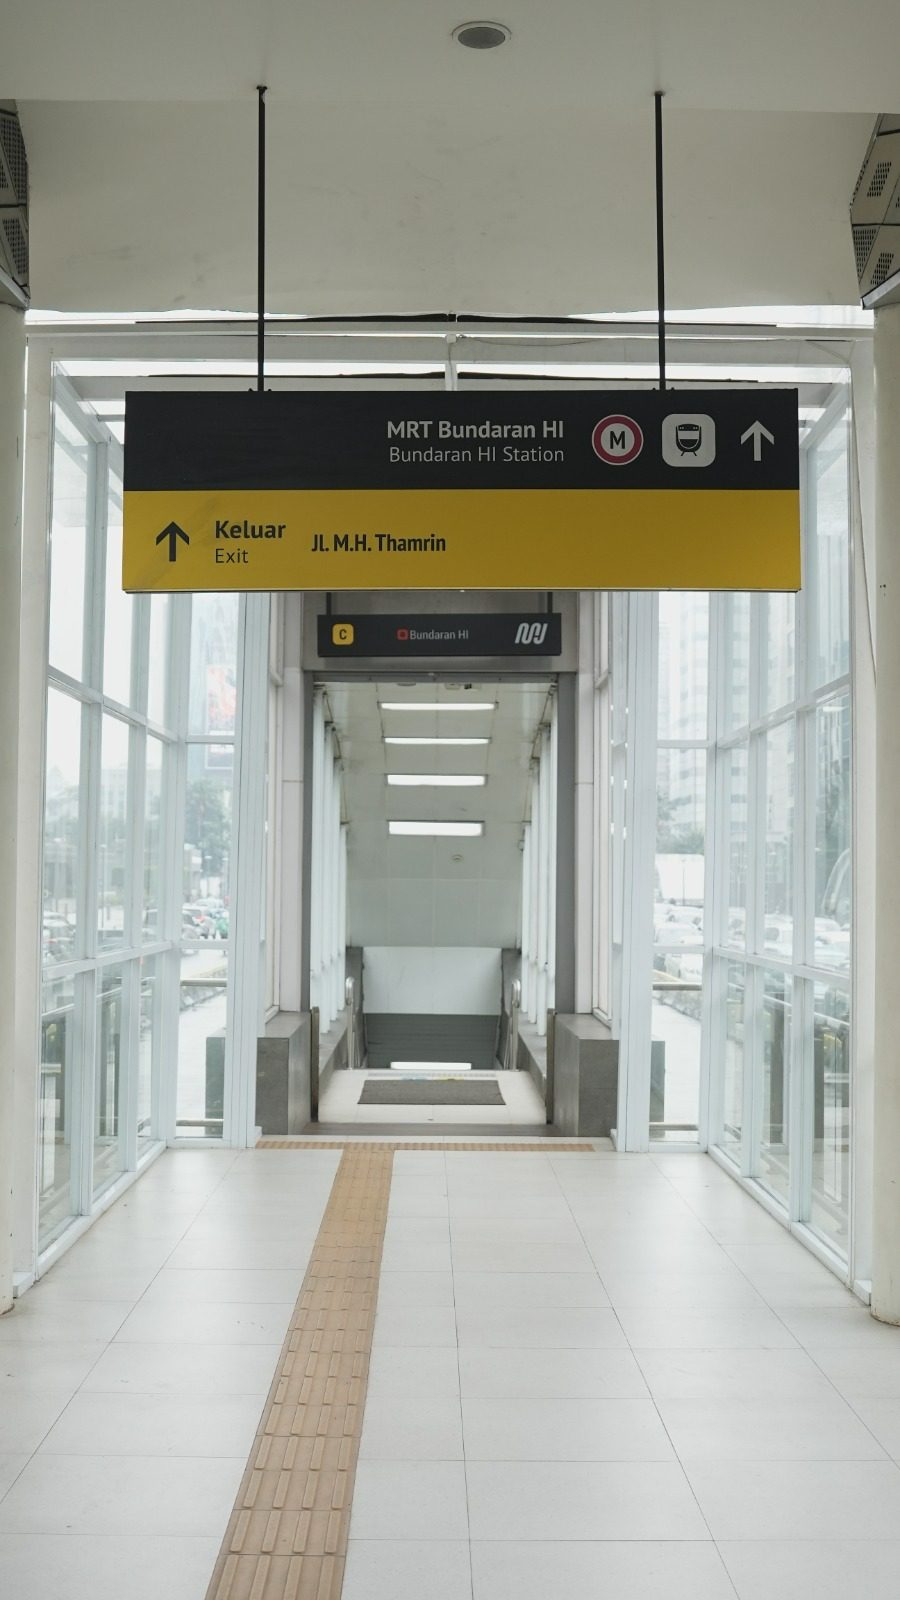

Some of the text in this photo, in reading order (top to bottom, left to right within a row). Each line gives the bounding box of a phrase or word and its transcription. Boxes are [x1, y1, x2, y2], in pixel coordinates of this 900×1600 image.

[387, 420, 564, 439] MRT Bundaran HI
[609, 431, 626, 449] M
[389, 446, 564, 463] Bundaran HI Station
[215, 520, 286, 539] Keluar
[311, 534, 446, 552] Jl. M.H. Thamrin
[215, 548, 249, 564] Exit
[338, 628, 347, 641] C
[409, 629, 469, 640] Bundaran HI
